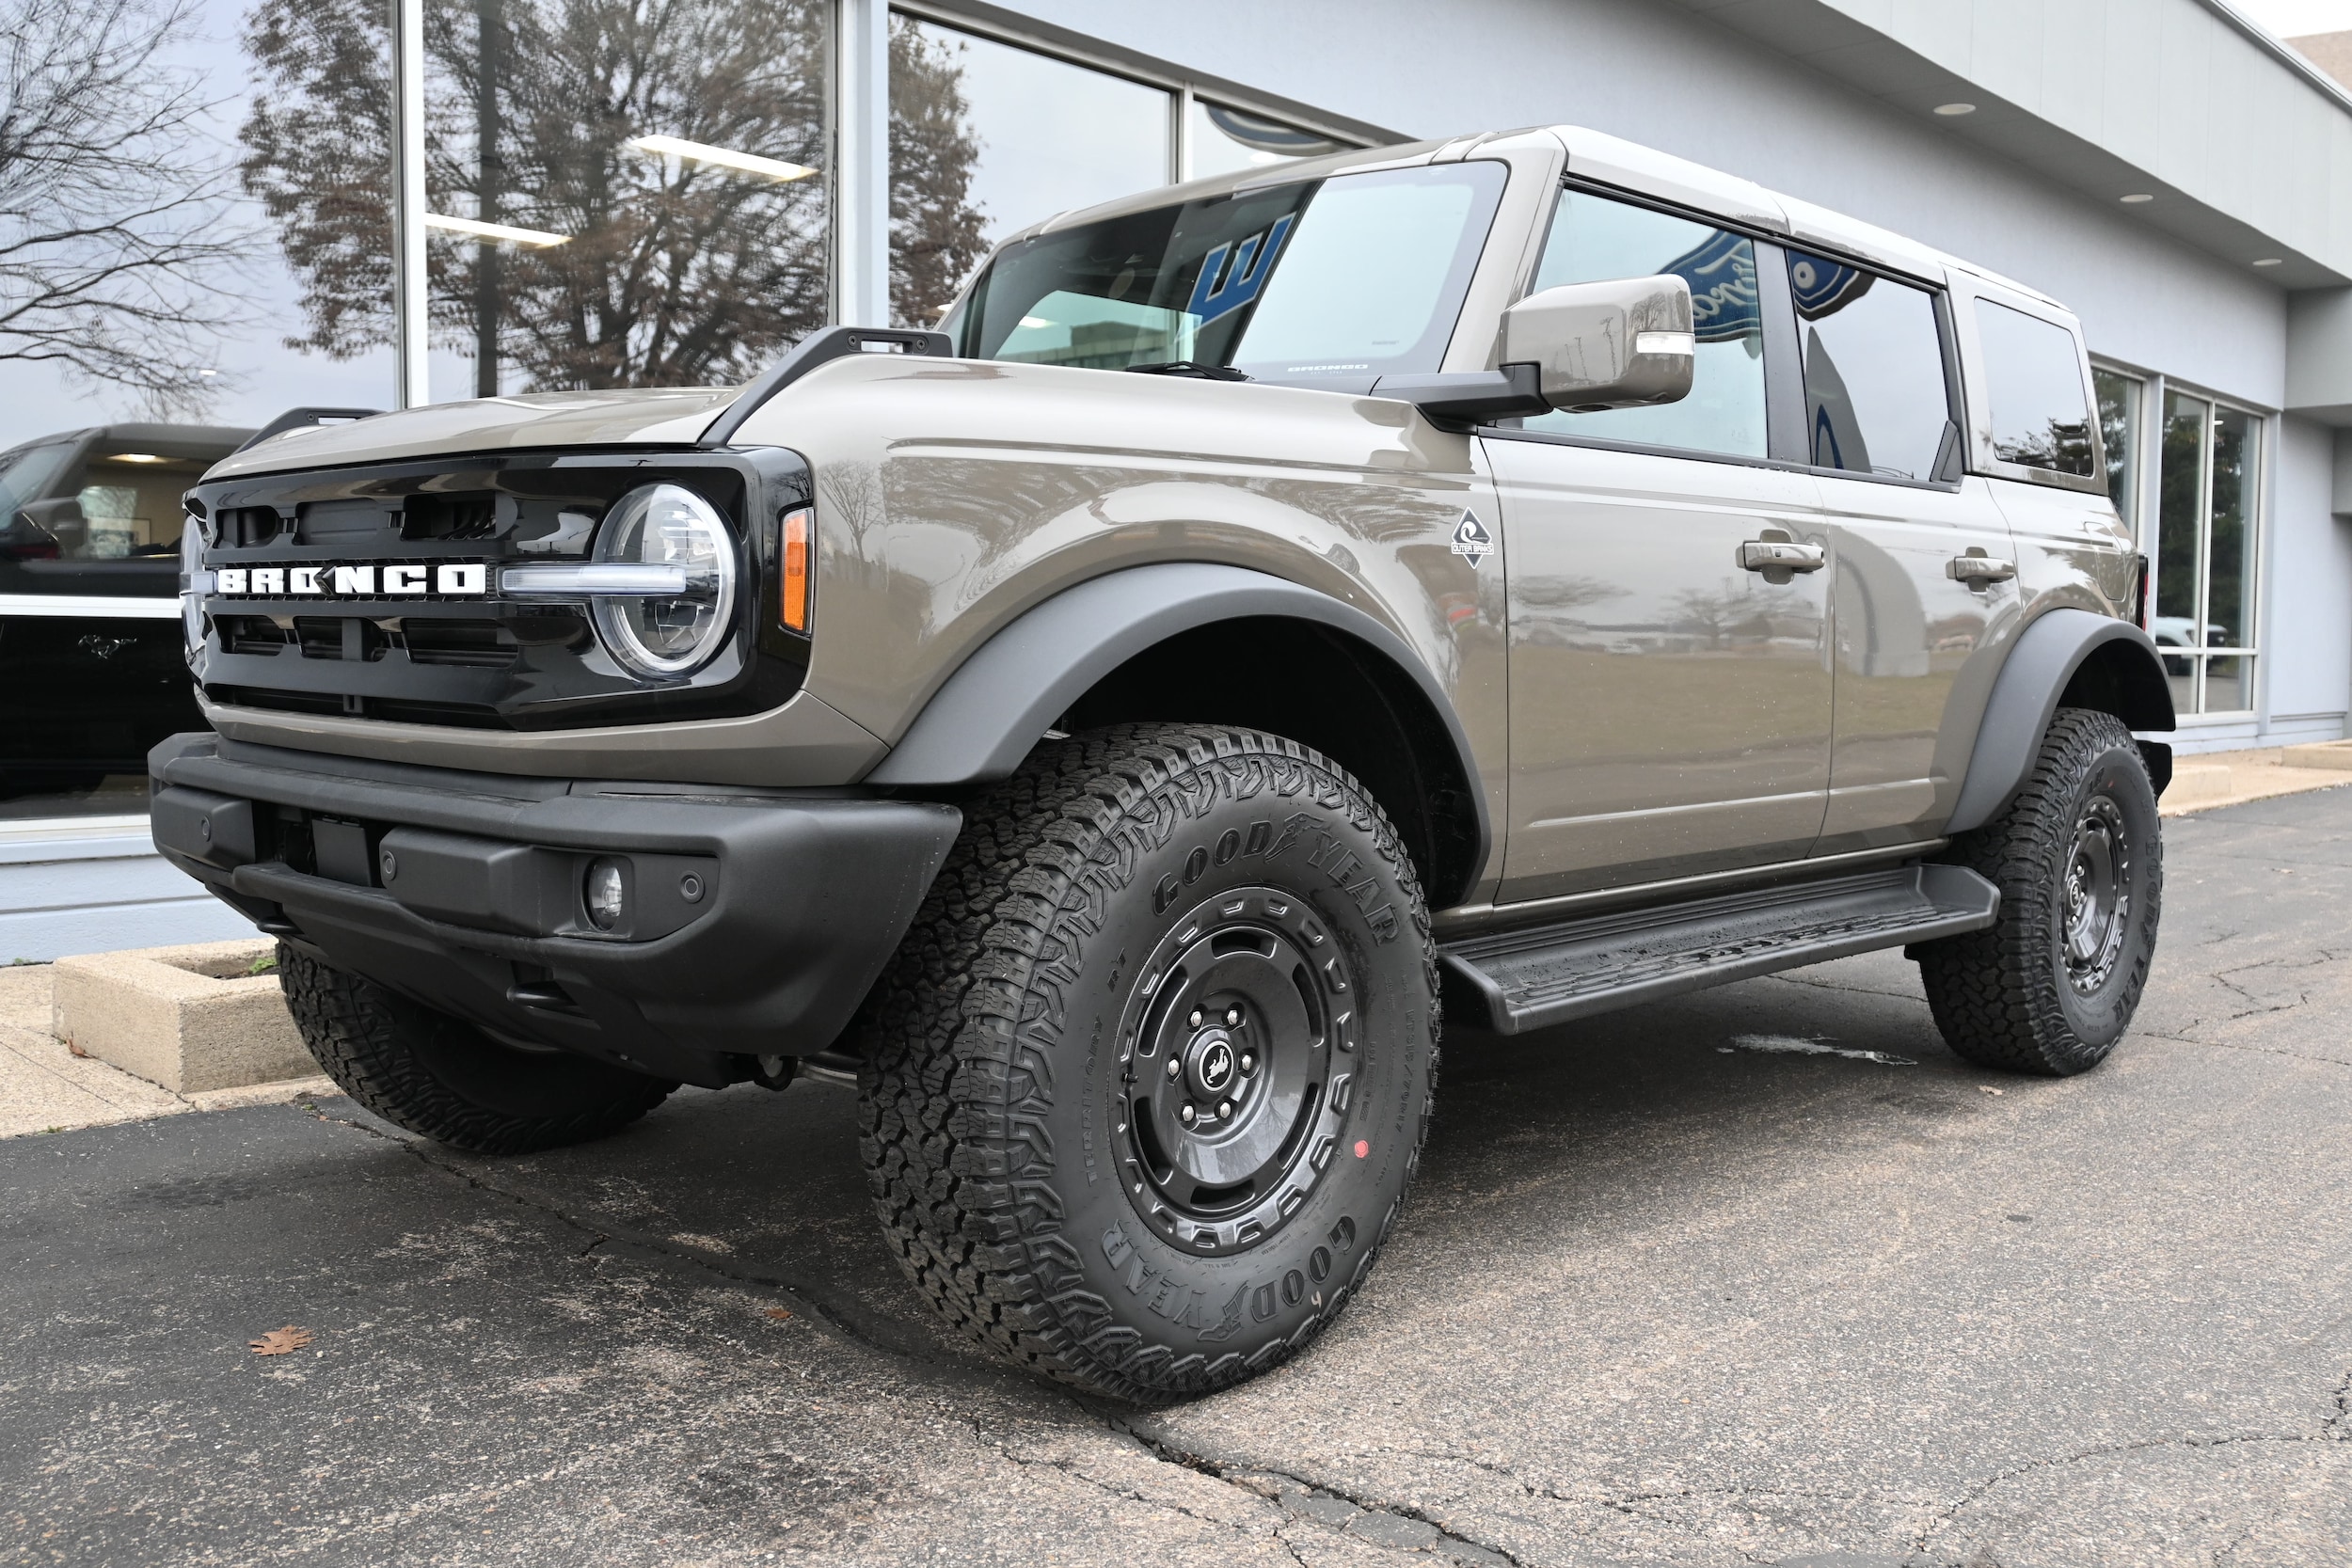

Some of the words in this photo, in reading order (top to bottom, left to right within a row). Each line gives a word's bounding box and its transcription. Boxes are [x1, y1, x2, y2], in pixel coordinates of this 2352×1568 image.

[1453, 545, 1472, 553] OUTER
[1473, 545, 1493, 553] BANKS
[217, 563, 486, 594] BRONCO
